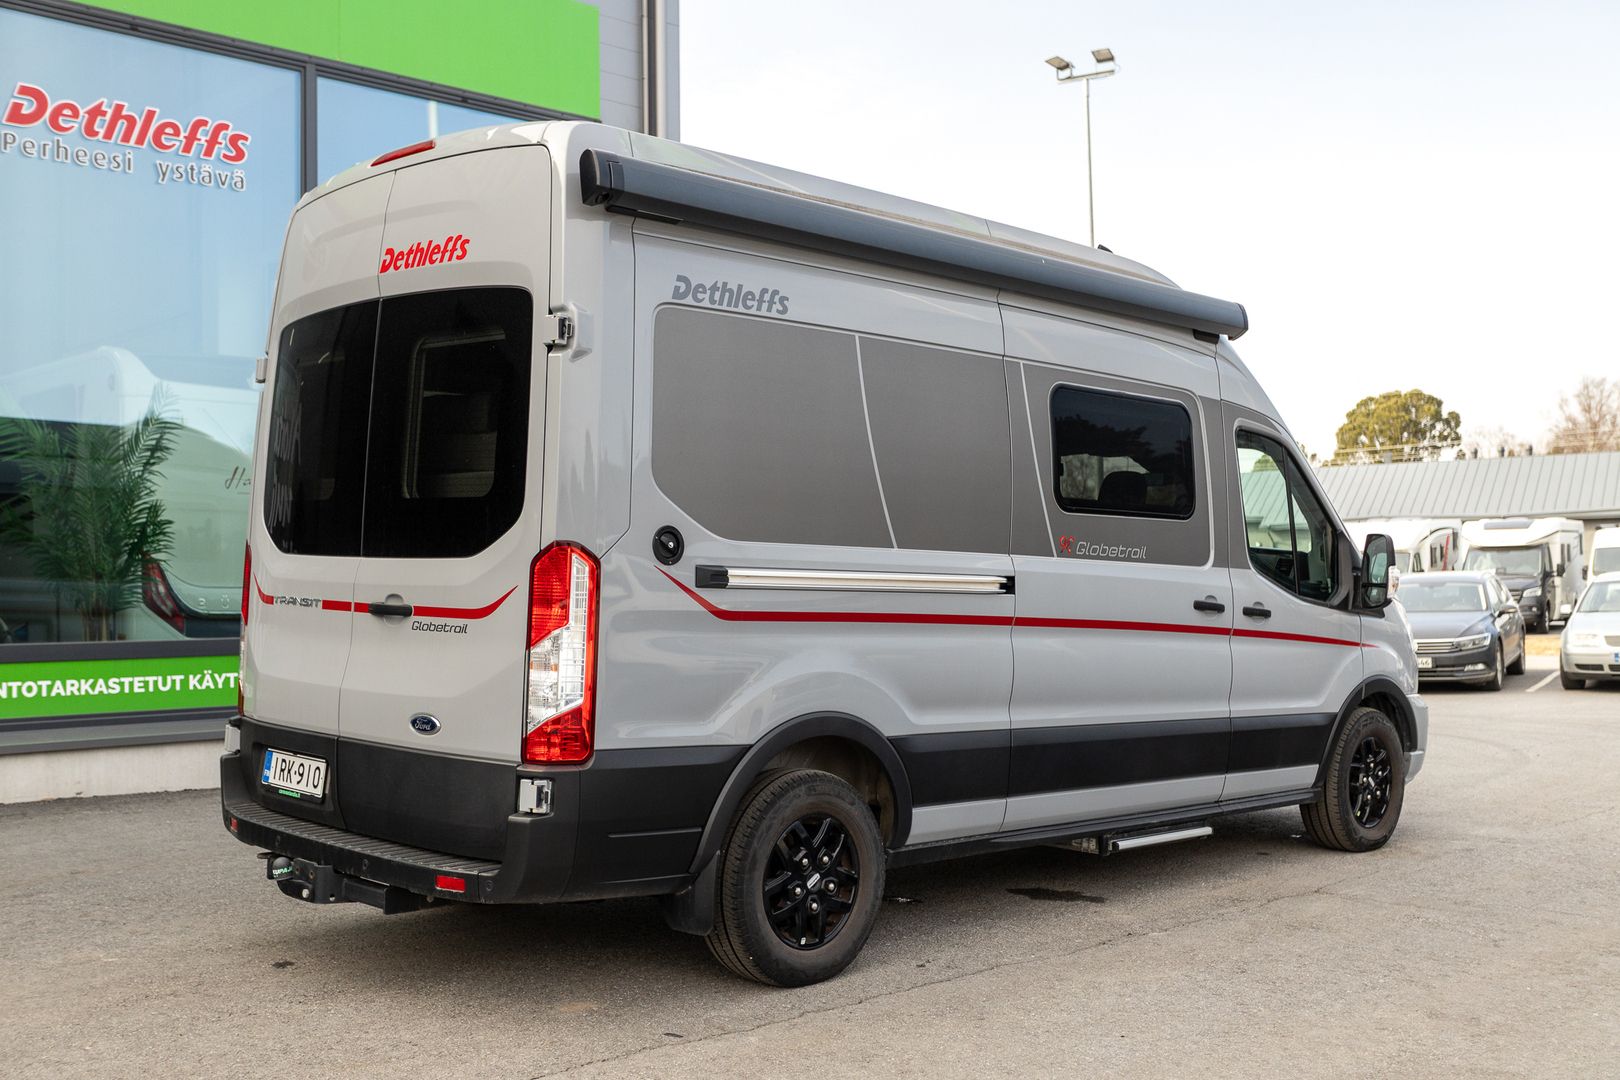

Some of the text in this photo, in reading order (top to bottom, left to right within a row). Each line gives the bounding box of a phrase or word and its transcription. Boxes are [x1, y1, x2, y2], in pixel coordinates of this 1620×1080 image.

[2, 82, 250, 163] Dethleffs
[1, 130, 246, 191] Perheesi ystävä
[379, 234, 471, 274] Dethleffs
[672, 274, 790, 316] Dethleffs
[1076, 541, 1147, 559] Globetrail
[274, 596, 321, 608] TRANSIT
[411, 620, 468, 634] Globetrail
[189, 669, 239, 691] KÄYT
[273, 756, 321, 789] IRK-910
